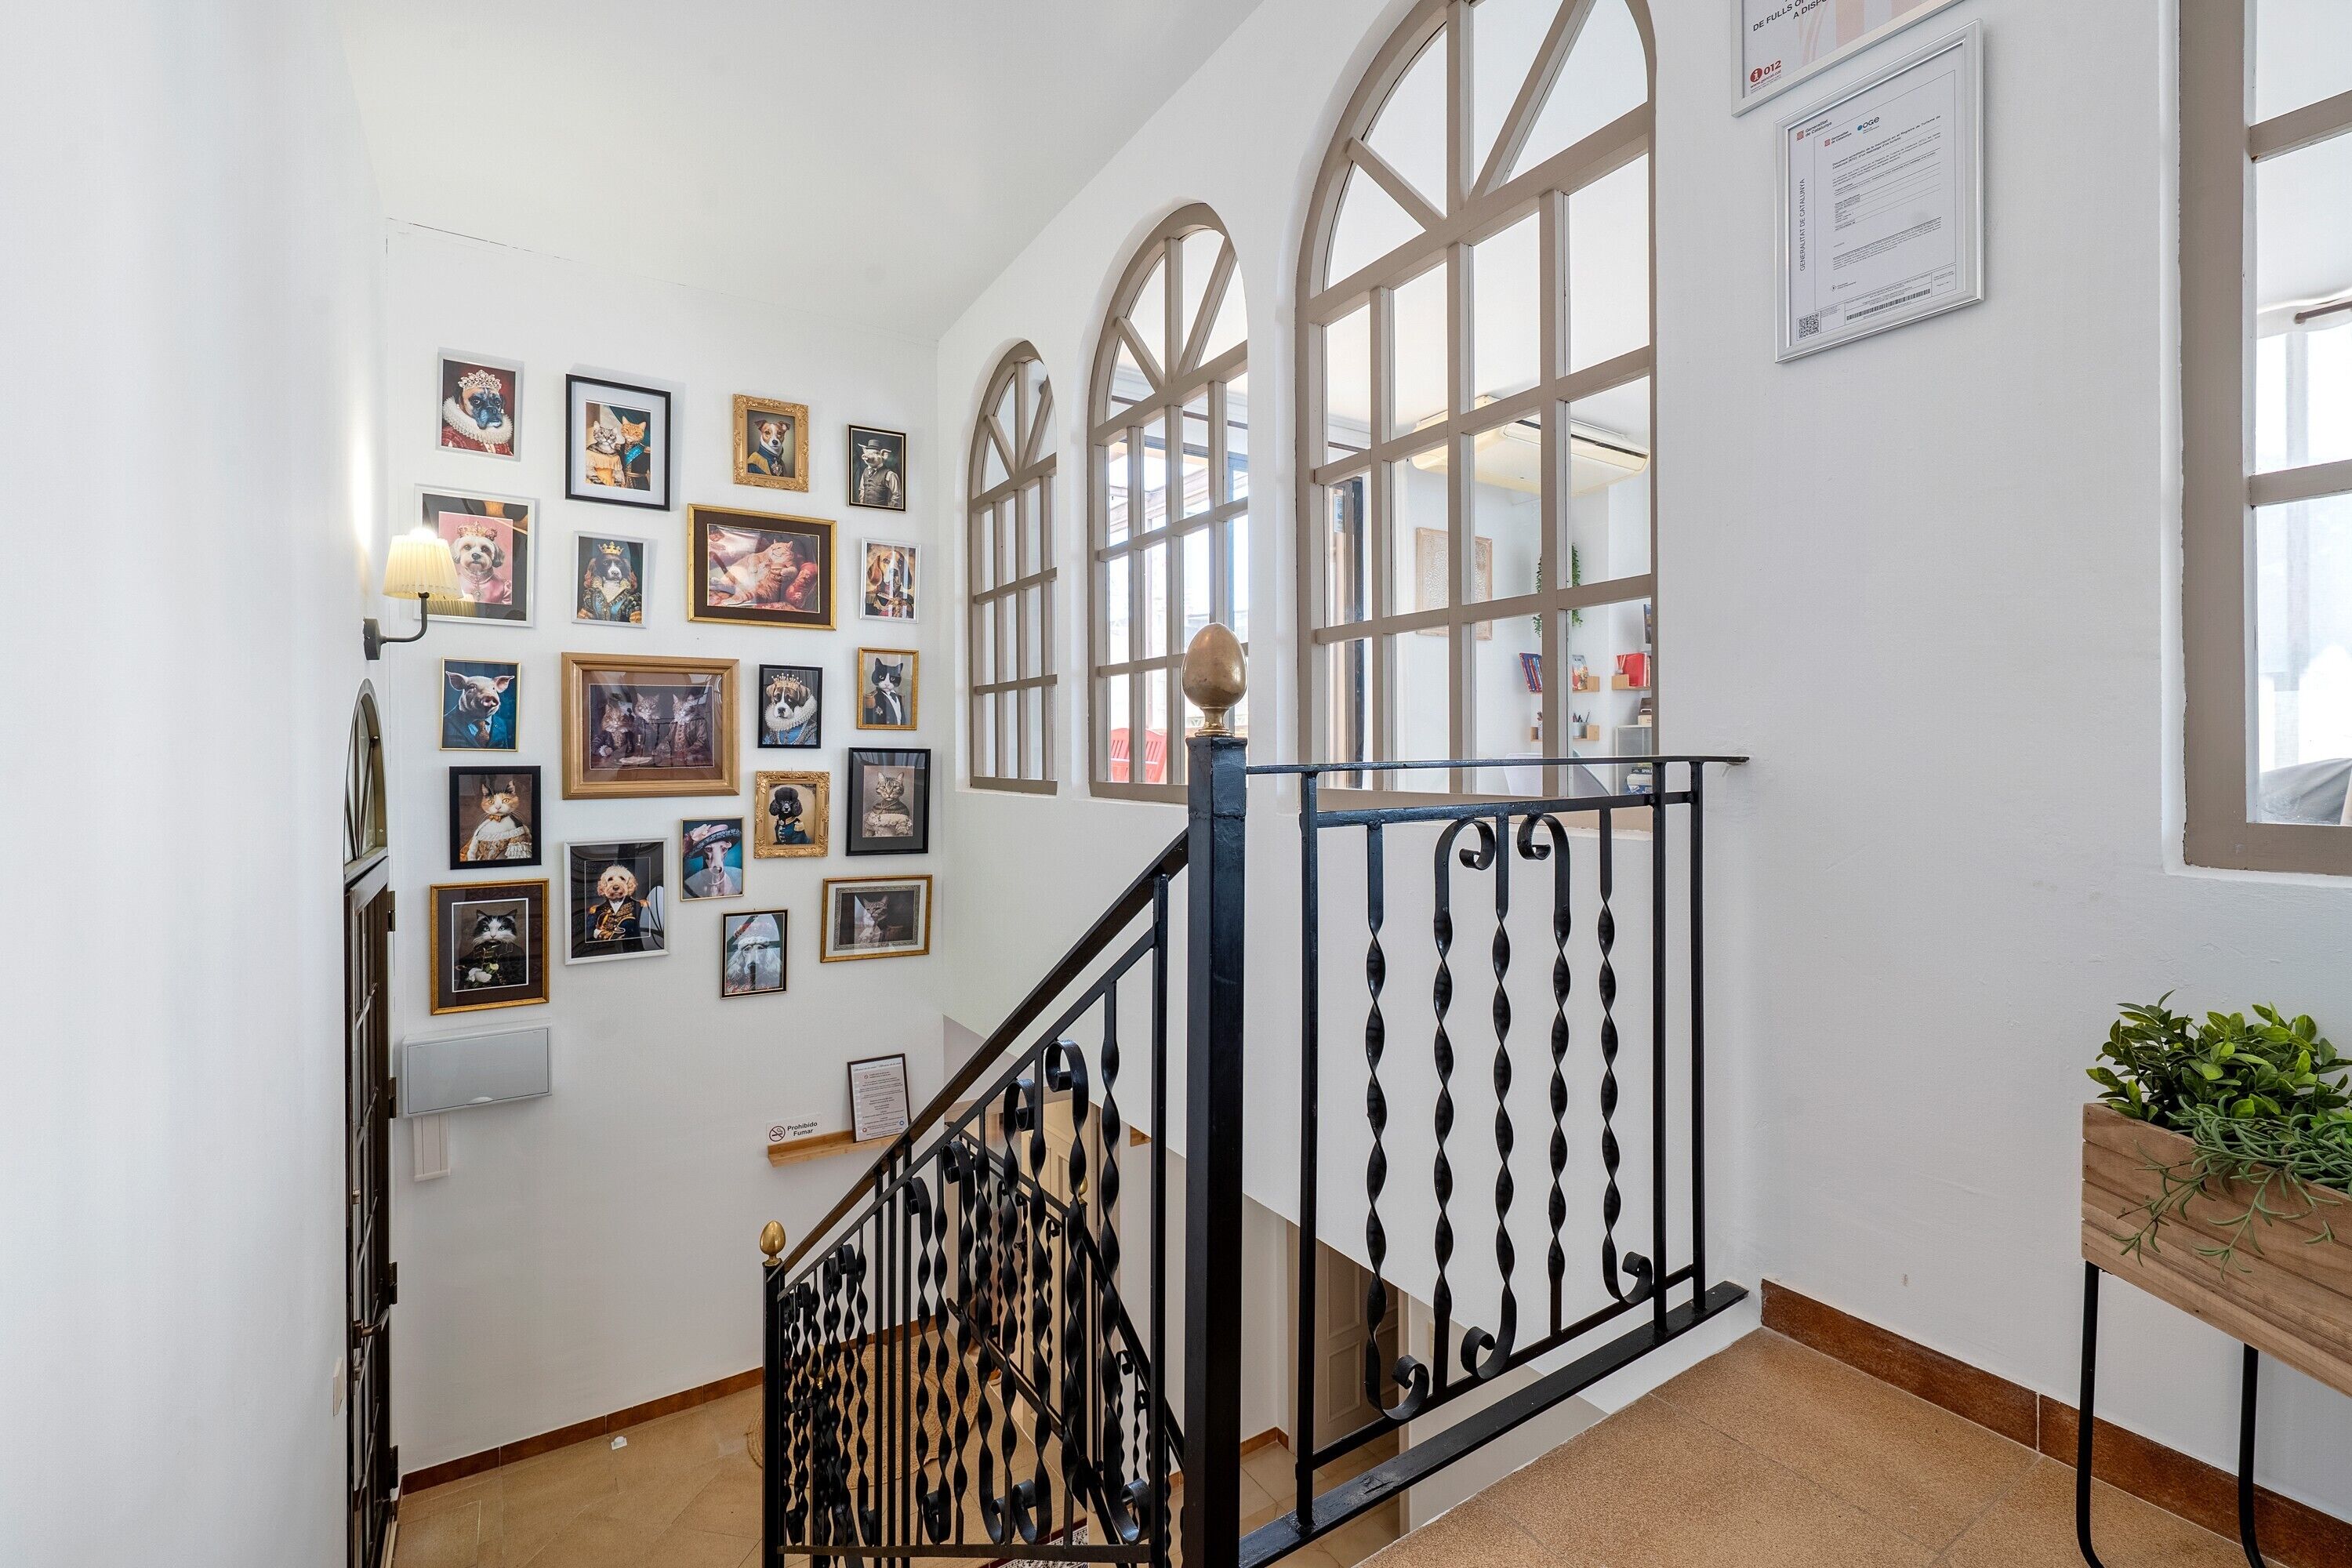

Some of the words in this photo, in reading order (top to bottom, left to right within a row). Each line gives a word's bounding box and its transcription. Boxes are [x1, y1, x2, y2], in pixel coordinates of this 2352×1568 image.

[1753, 20, 1764, 31] DE
[1766, 4, 1792, 24] FULLS
[1793, 11, 1799, 20] A
[1764, 60, 1781, 75] 012
[1805, 118, 1828, 133] Generalitat
[1811, 122, 1832, 134] Catalunya
[1799, 217, 1806, 227] DE
[787, 1121, 818, 1131] Prohibido
[793, 1128, 814, 1137] Fumar
